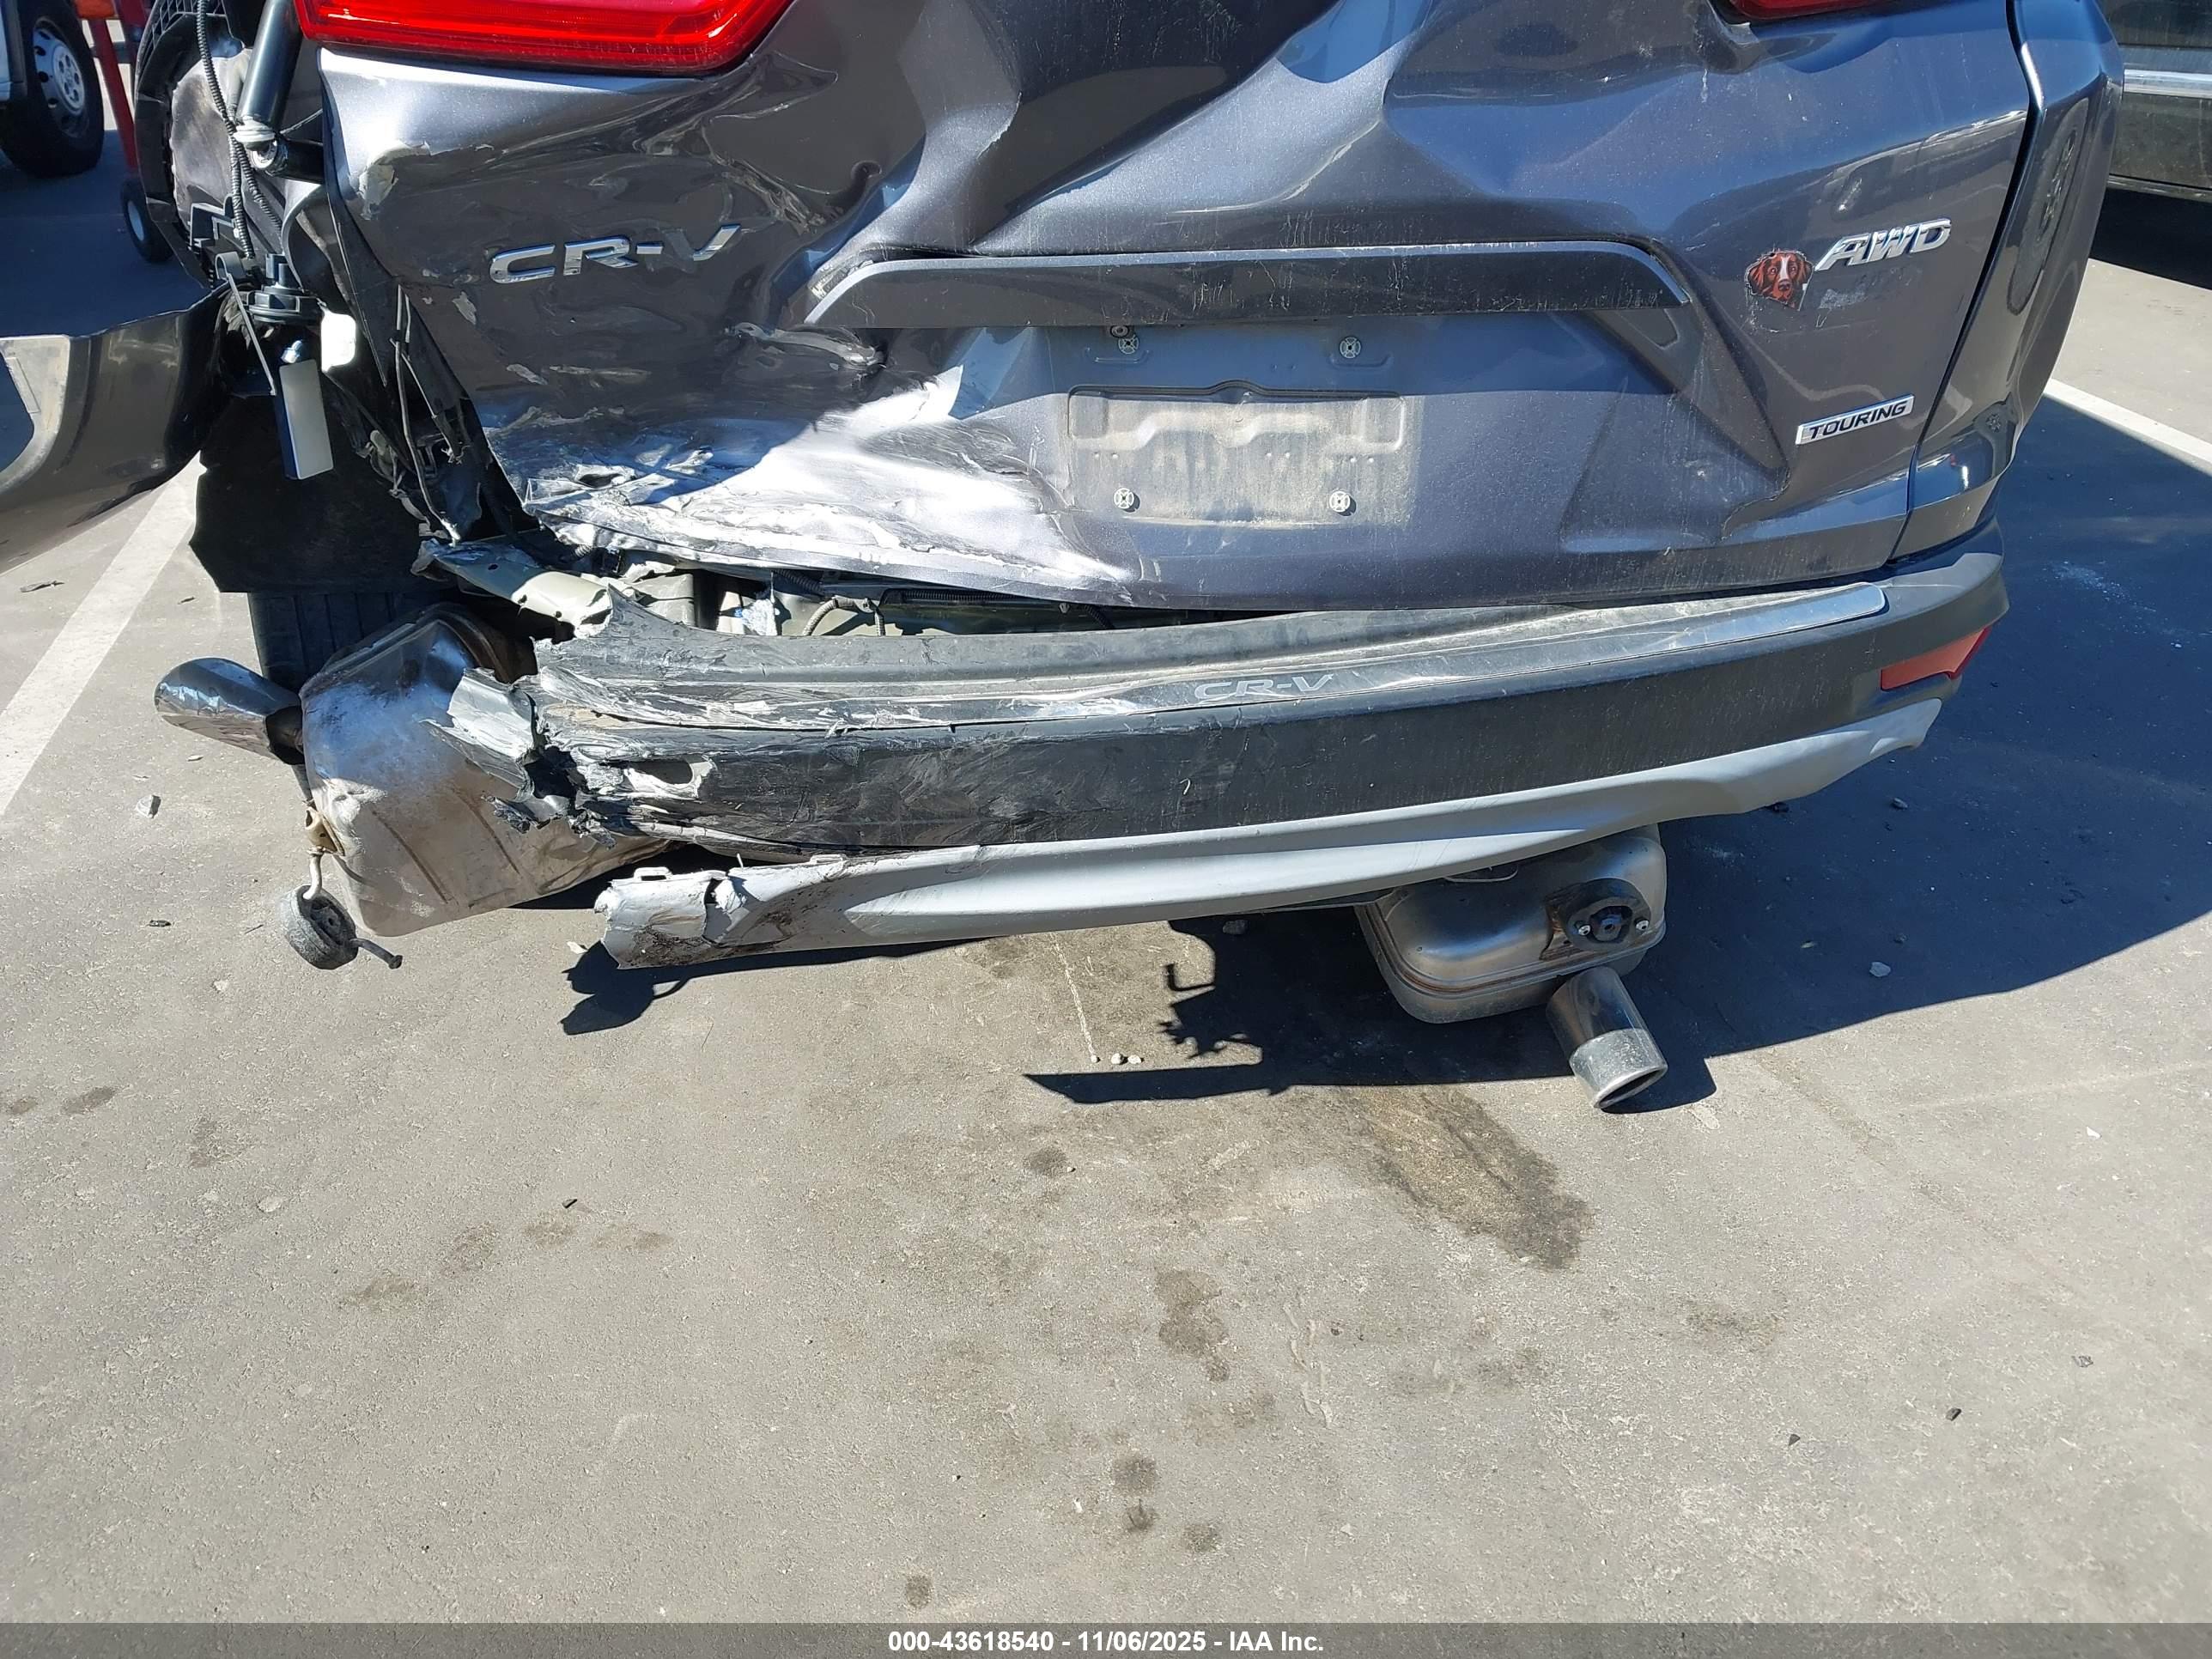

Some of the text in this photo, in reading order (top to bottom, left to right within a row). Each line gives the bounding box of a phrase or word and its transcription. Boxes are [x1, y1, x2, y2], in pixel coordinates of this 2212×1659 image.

[489, 223, 740, 284] CR-V
[1814, 217, 1952, 271] AWD
[1809, 400, 1908, 440] TOURING
[1194, 673, 1334, 700] CR-V
